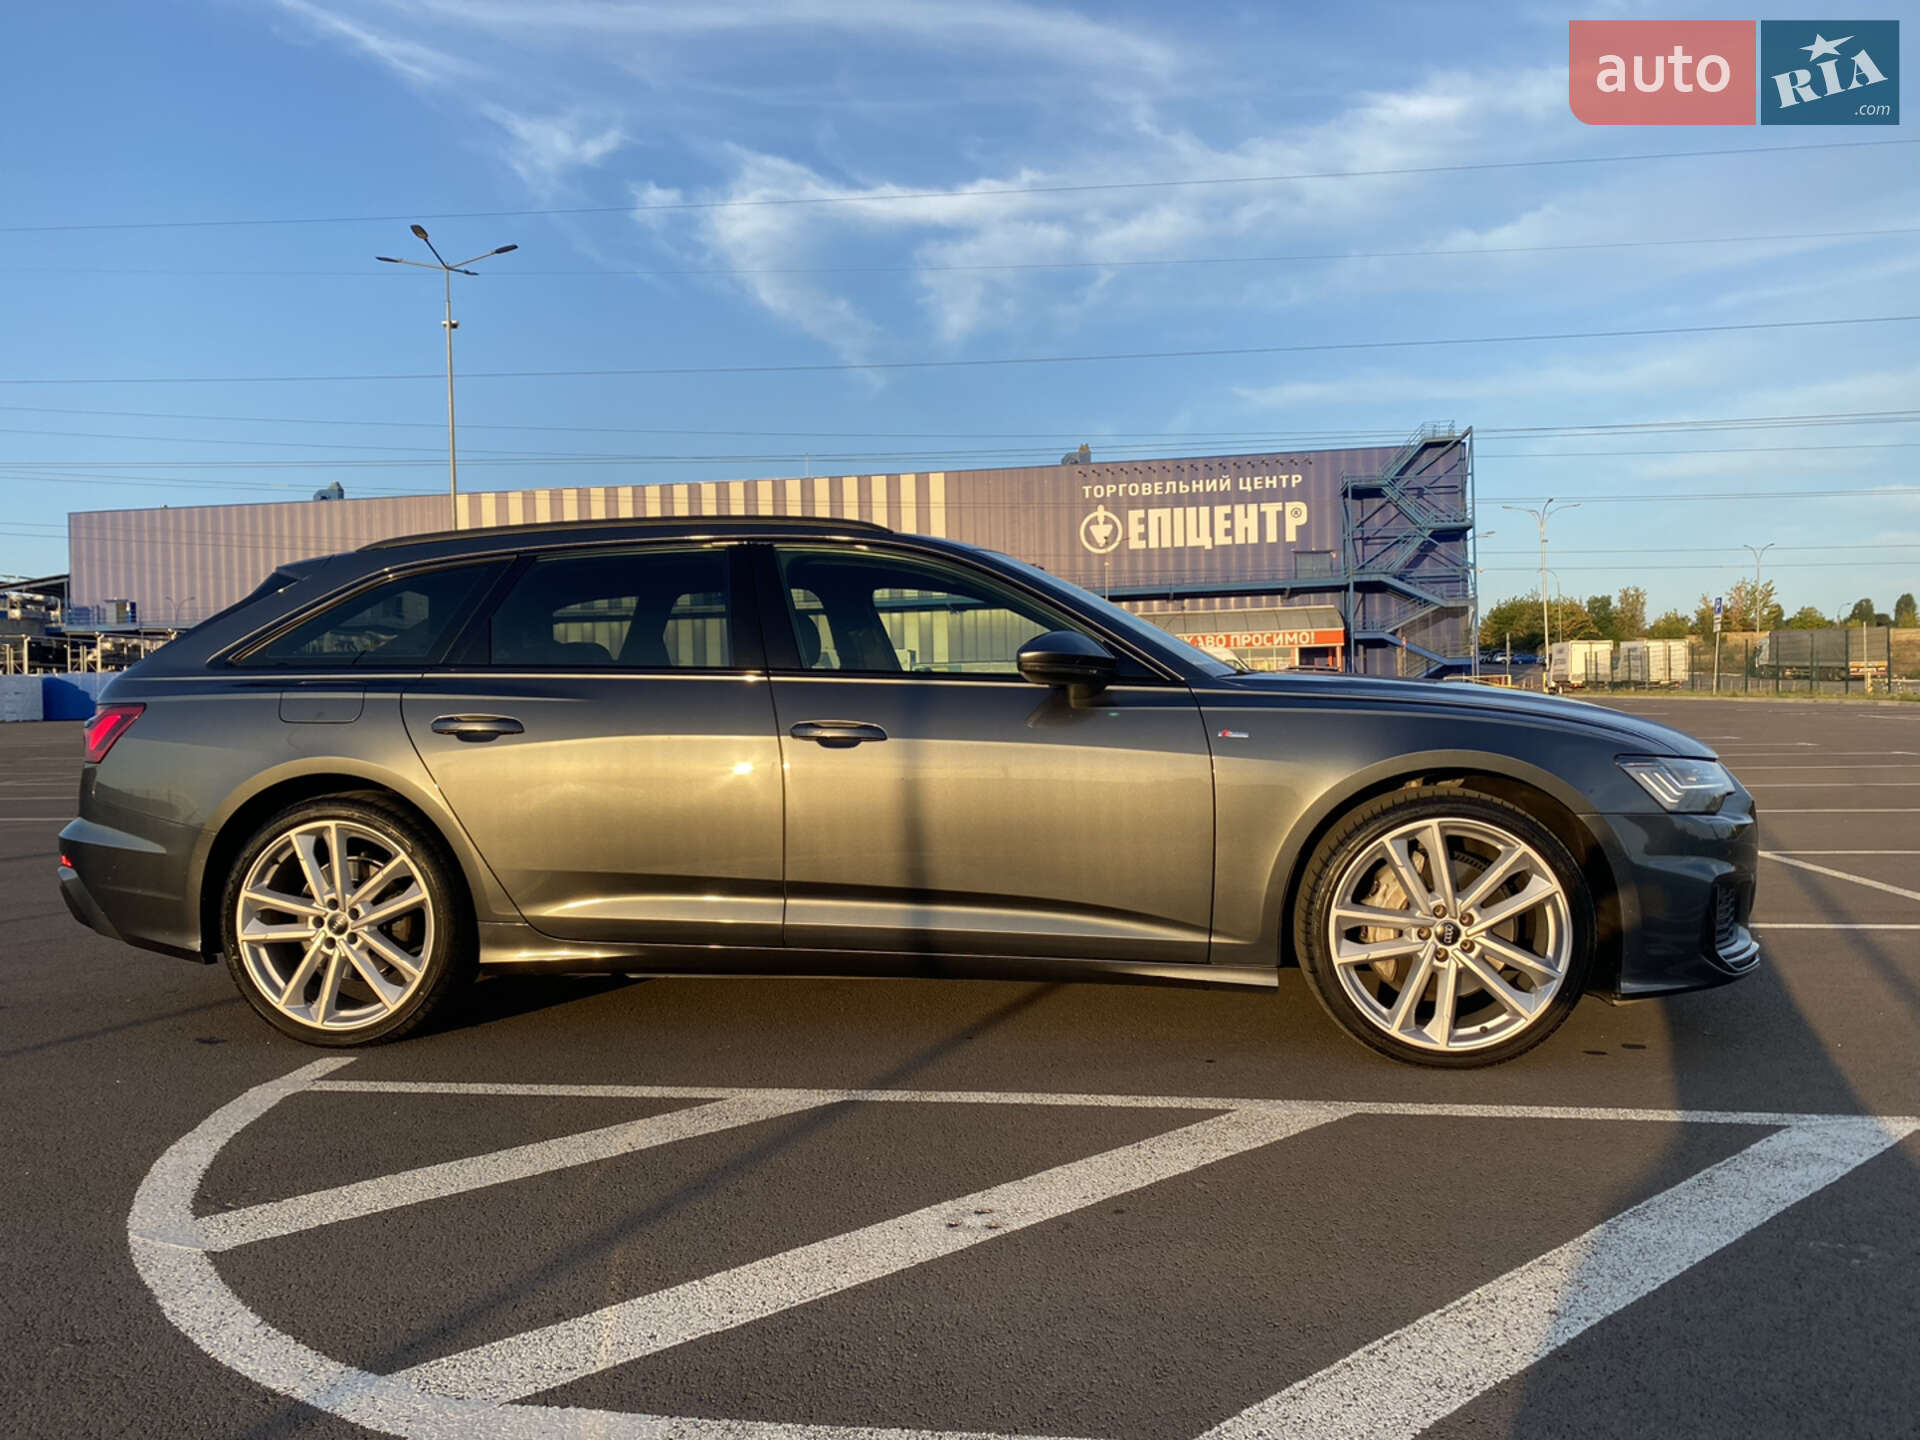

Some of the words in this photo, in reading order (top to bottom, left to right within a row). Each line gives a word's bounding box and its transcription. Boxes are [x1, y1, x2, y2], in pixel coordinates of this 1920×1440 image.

[1081, 474, 1232, 499] ТОРГОВЕЛЬНИЙ
[1238, 474, 1303, 492] ЦЕНТР
[1127, 501, 1308, 550] ЕПІЦЕНТР
[1178, 634, 1226, 648] КАВО
[1230, 631, 1315, 648] ПРОСИМО!
